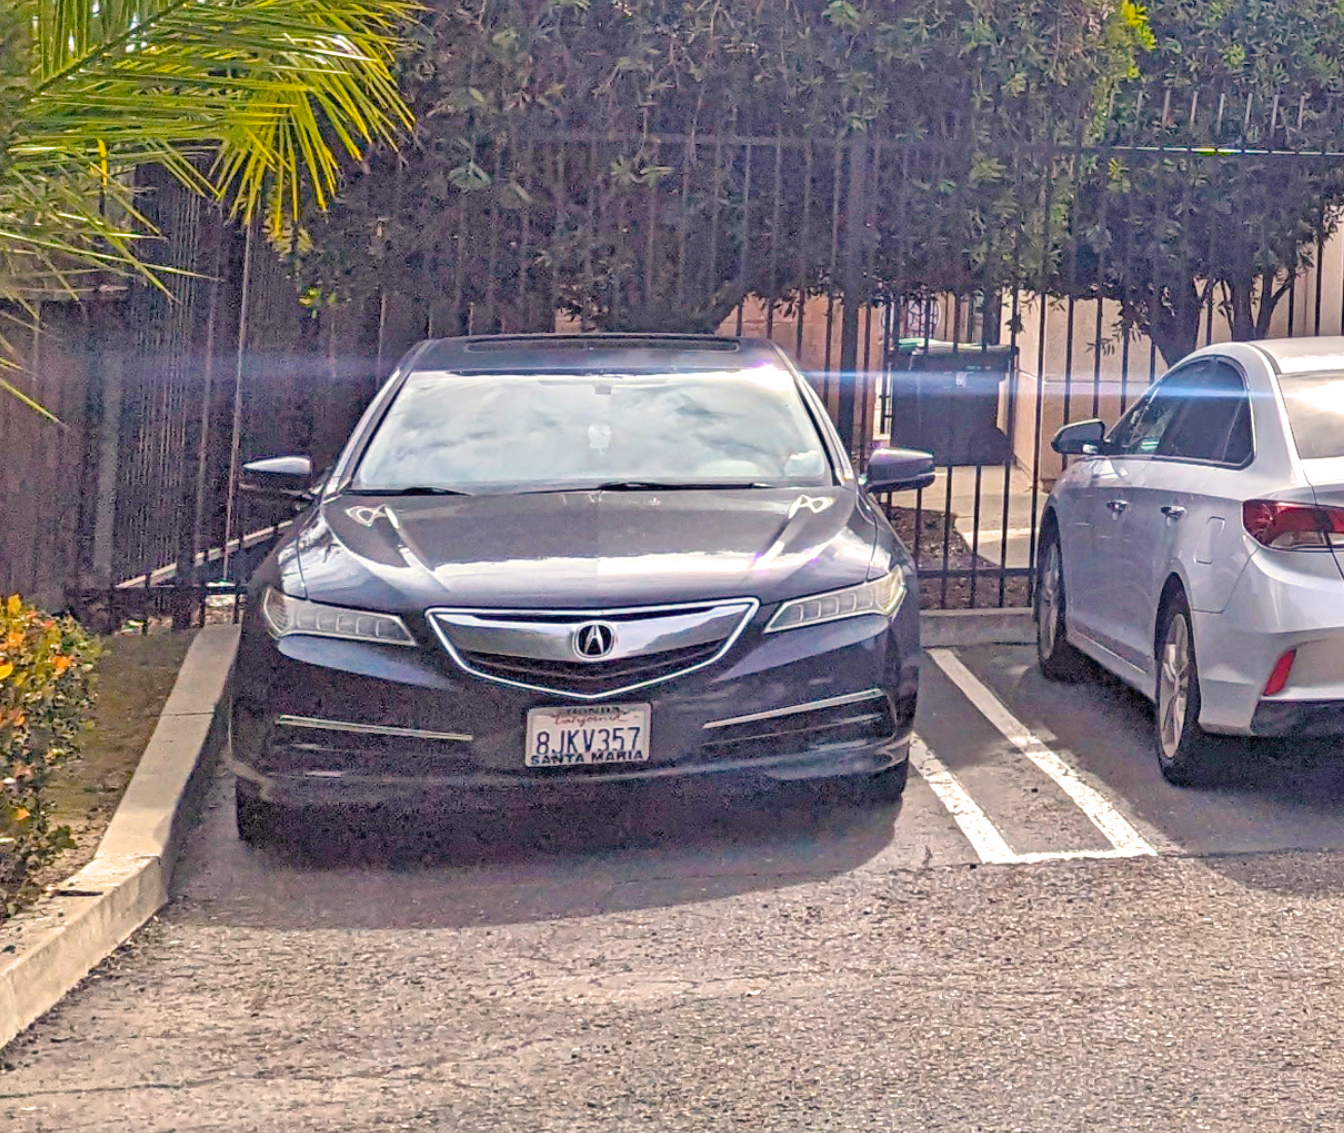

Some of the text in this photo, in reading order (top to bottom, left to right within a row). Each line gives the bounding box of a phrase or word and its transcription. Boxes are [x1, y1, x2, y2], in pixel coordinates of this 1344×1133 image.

[536, 726, 641, 755] 8JKV357
[530, 750, 644, 766] SANTA MARIA
